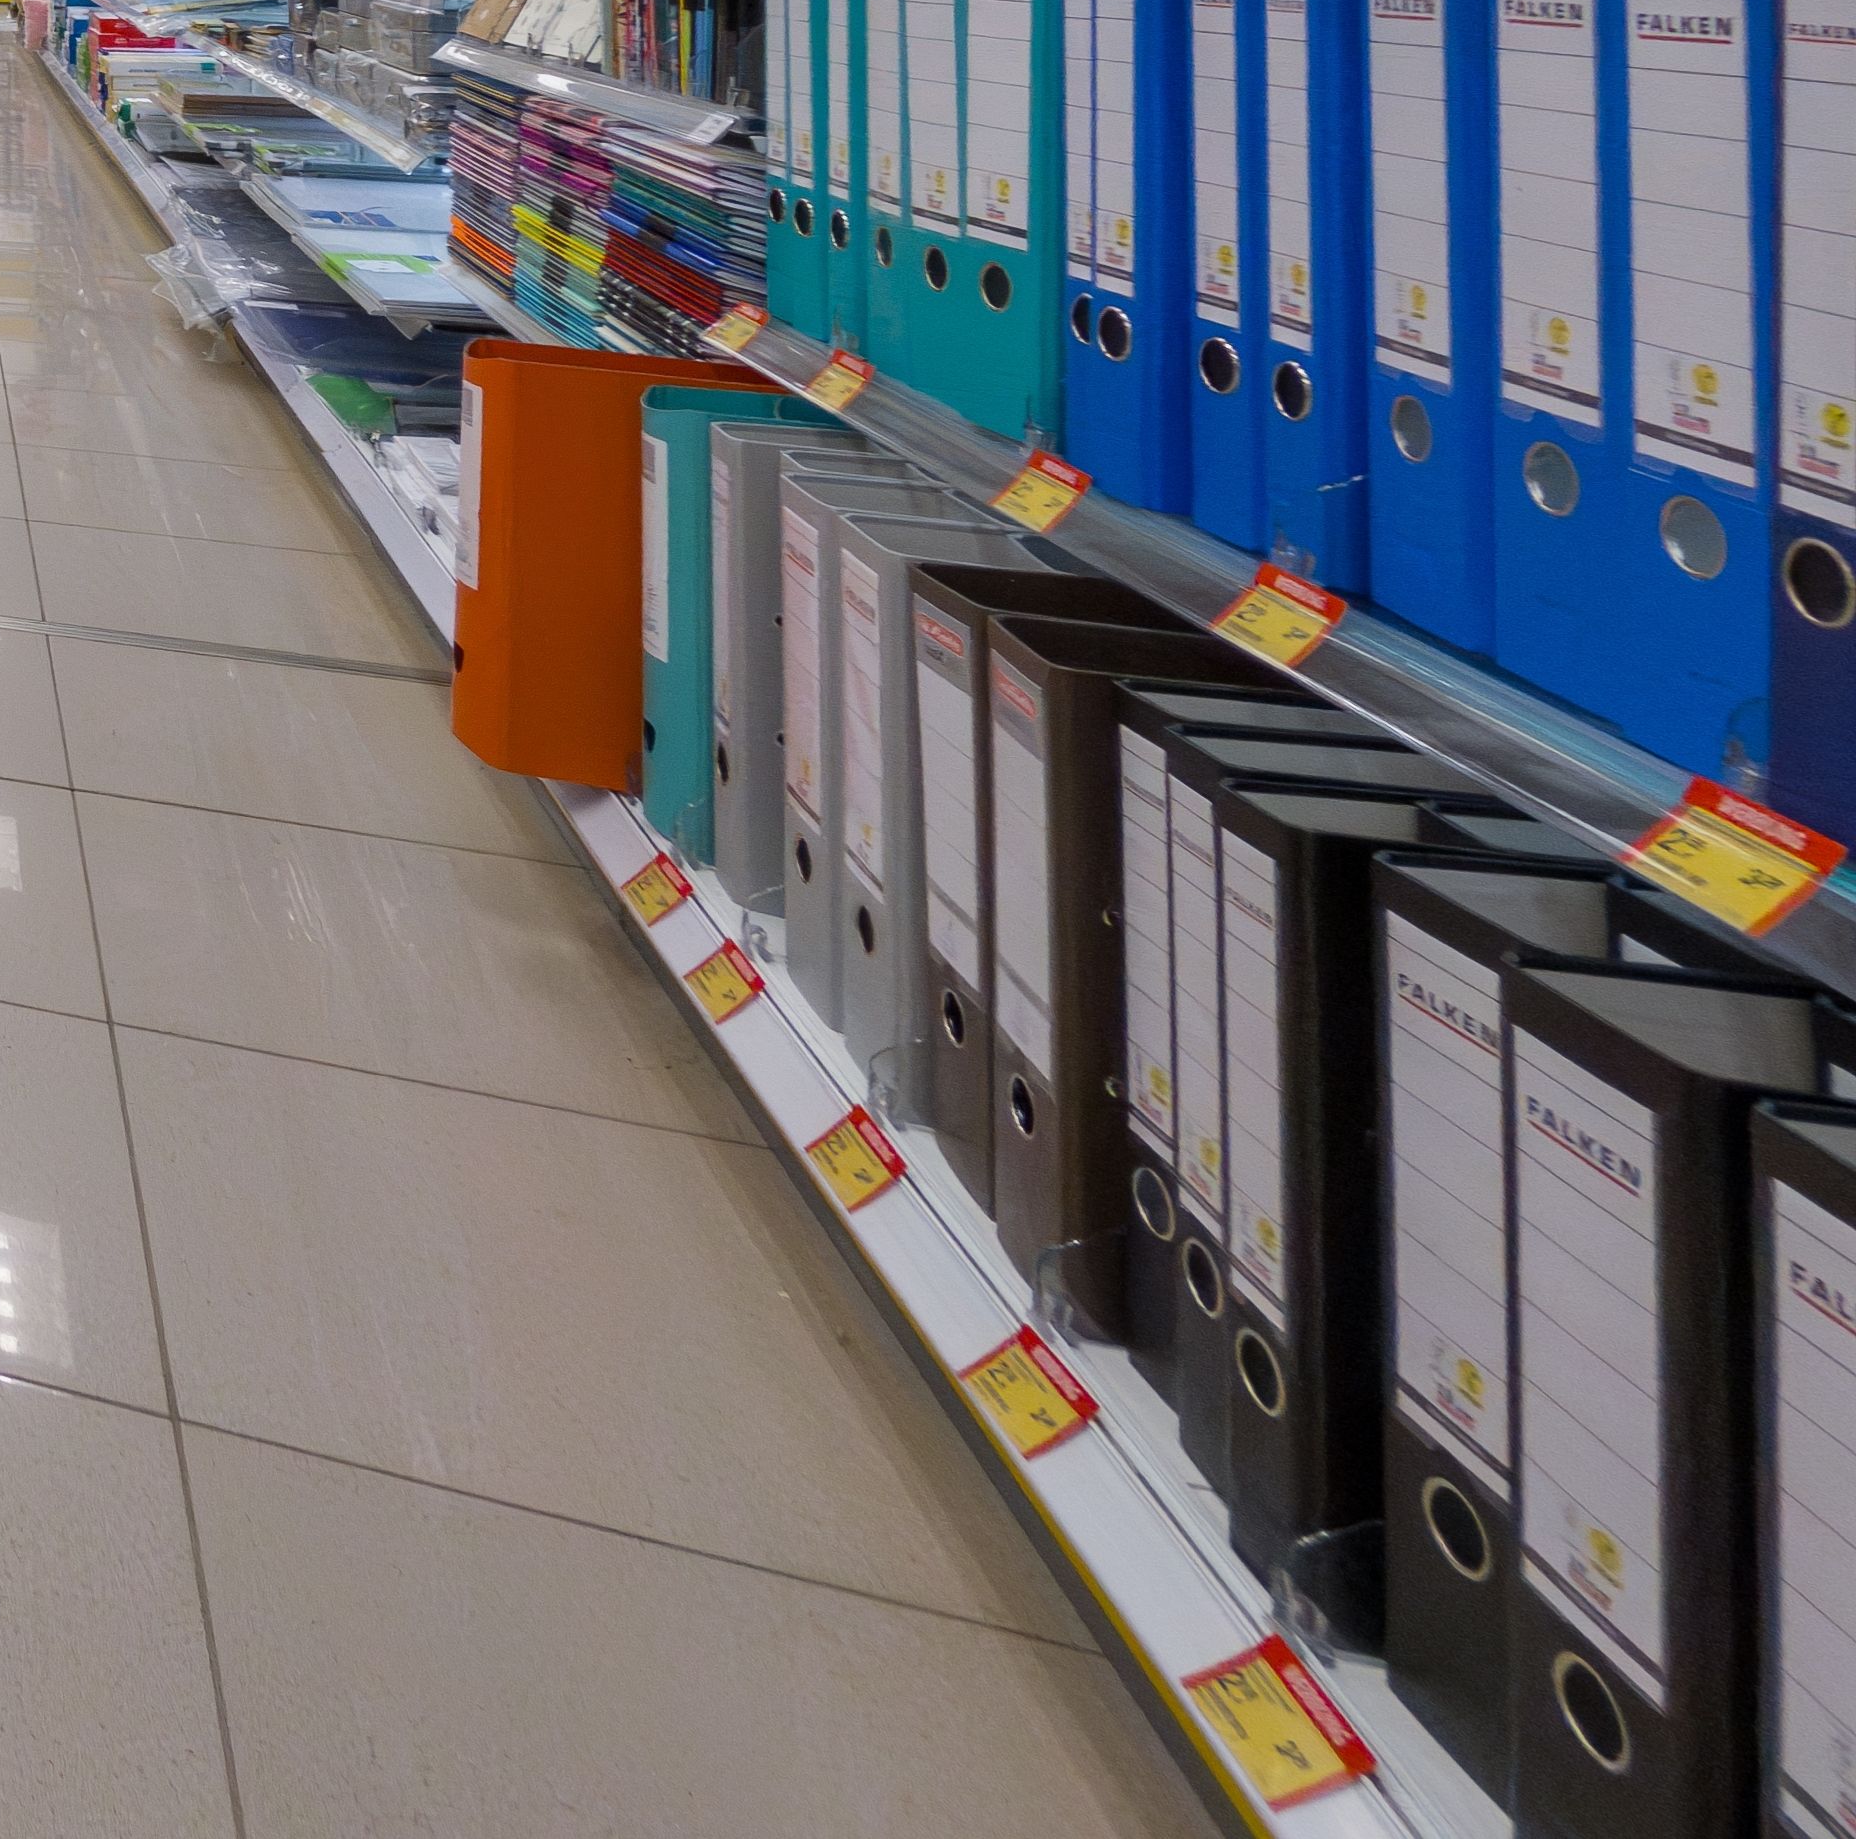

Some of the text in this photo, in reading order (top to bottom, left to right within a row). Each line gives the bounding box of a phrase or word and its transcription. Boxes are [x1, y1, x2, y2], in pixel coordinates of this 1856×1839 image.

[1504, 0, 1584, 22] FALKEN
[1635, 13, 1734, 38] FALKEN
[1787, 23, 1856, 41] FALKEN
[1396, 972, 1501, 1053] FALKEN
[1525, 1093, 1641, 1191] FALKEN
